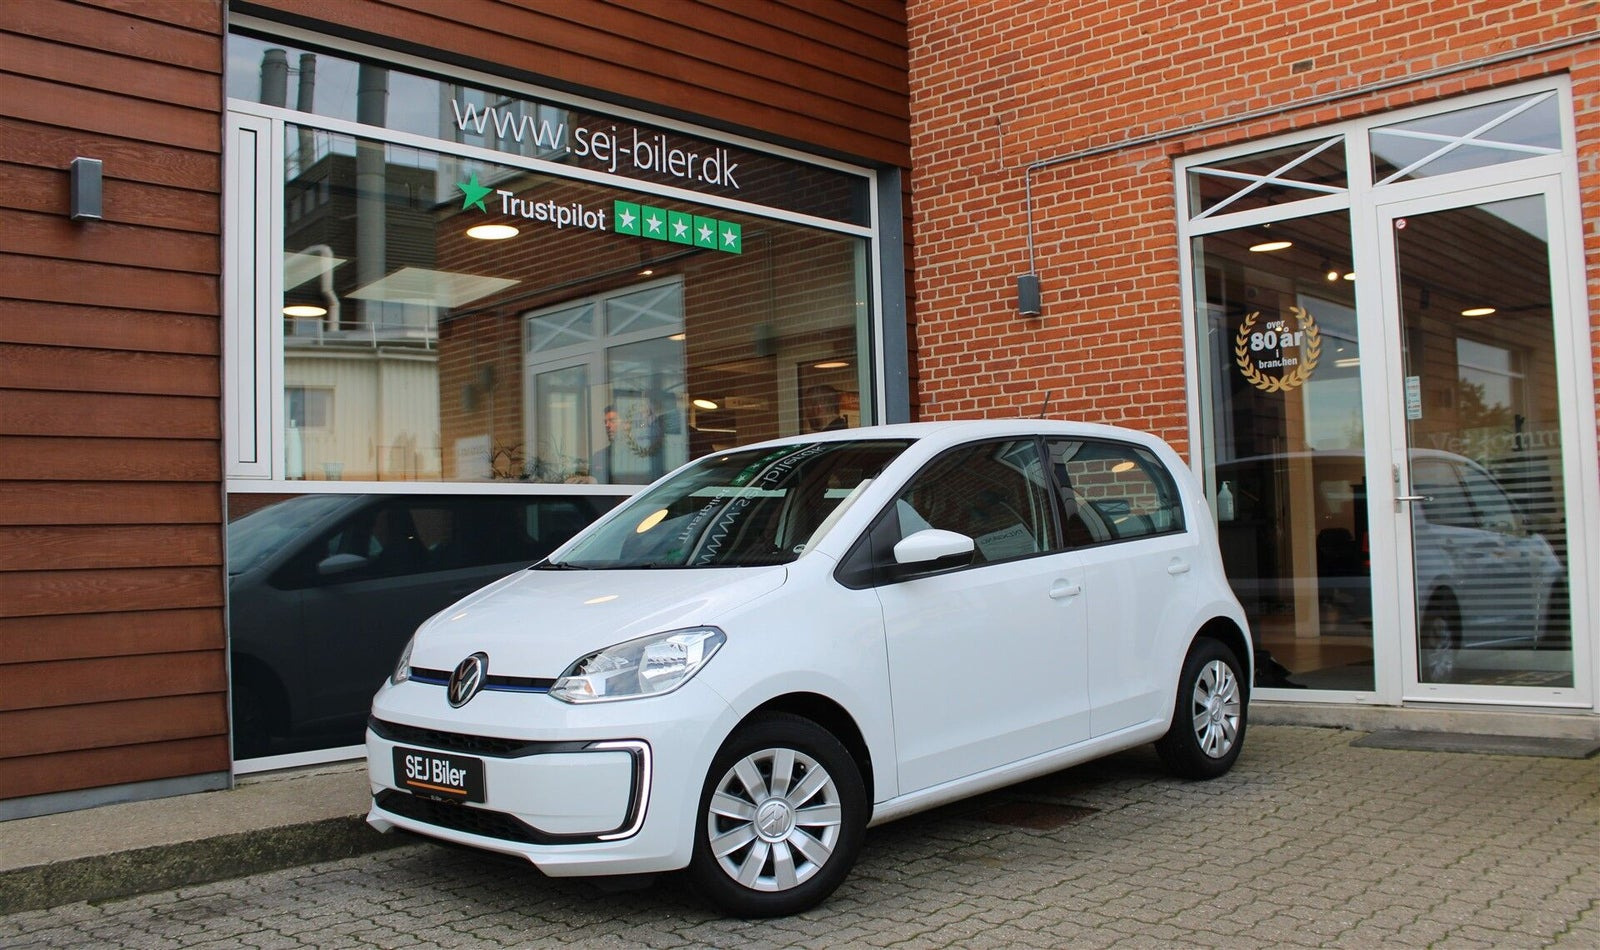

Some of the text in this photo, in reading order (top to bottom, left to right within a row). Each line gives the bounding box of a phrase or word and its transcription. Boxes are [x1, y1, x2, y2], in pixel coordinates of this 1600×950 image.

[451, 98, 740, 190] www.sej-biler.dk
[496, 189, 607, 232] Trustpilot
[1266, 320, 1285, 329] over
[1250, 327, 1303, 351] 80 år
[1258, 357, 1297, 369] branchen
[405, 754, 467, 787] SEJ Biler
